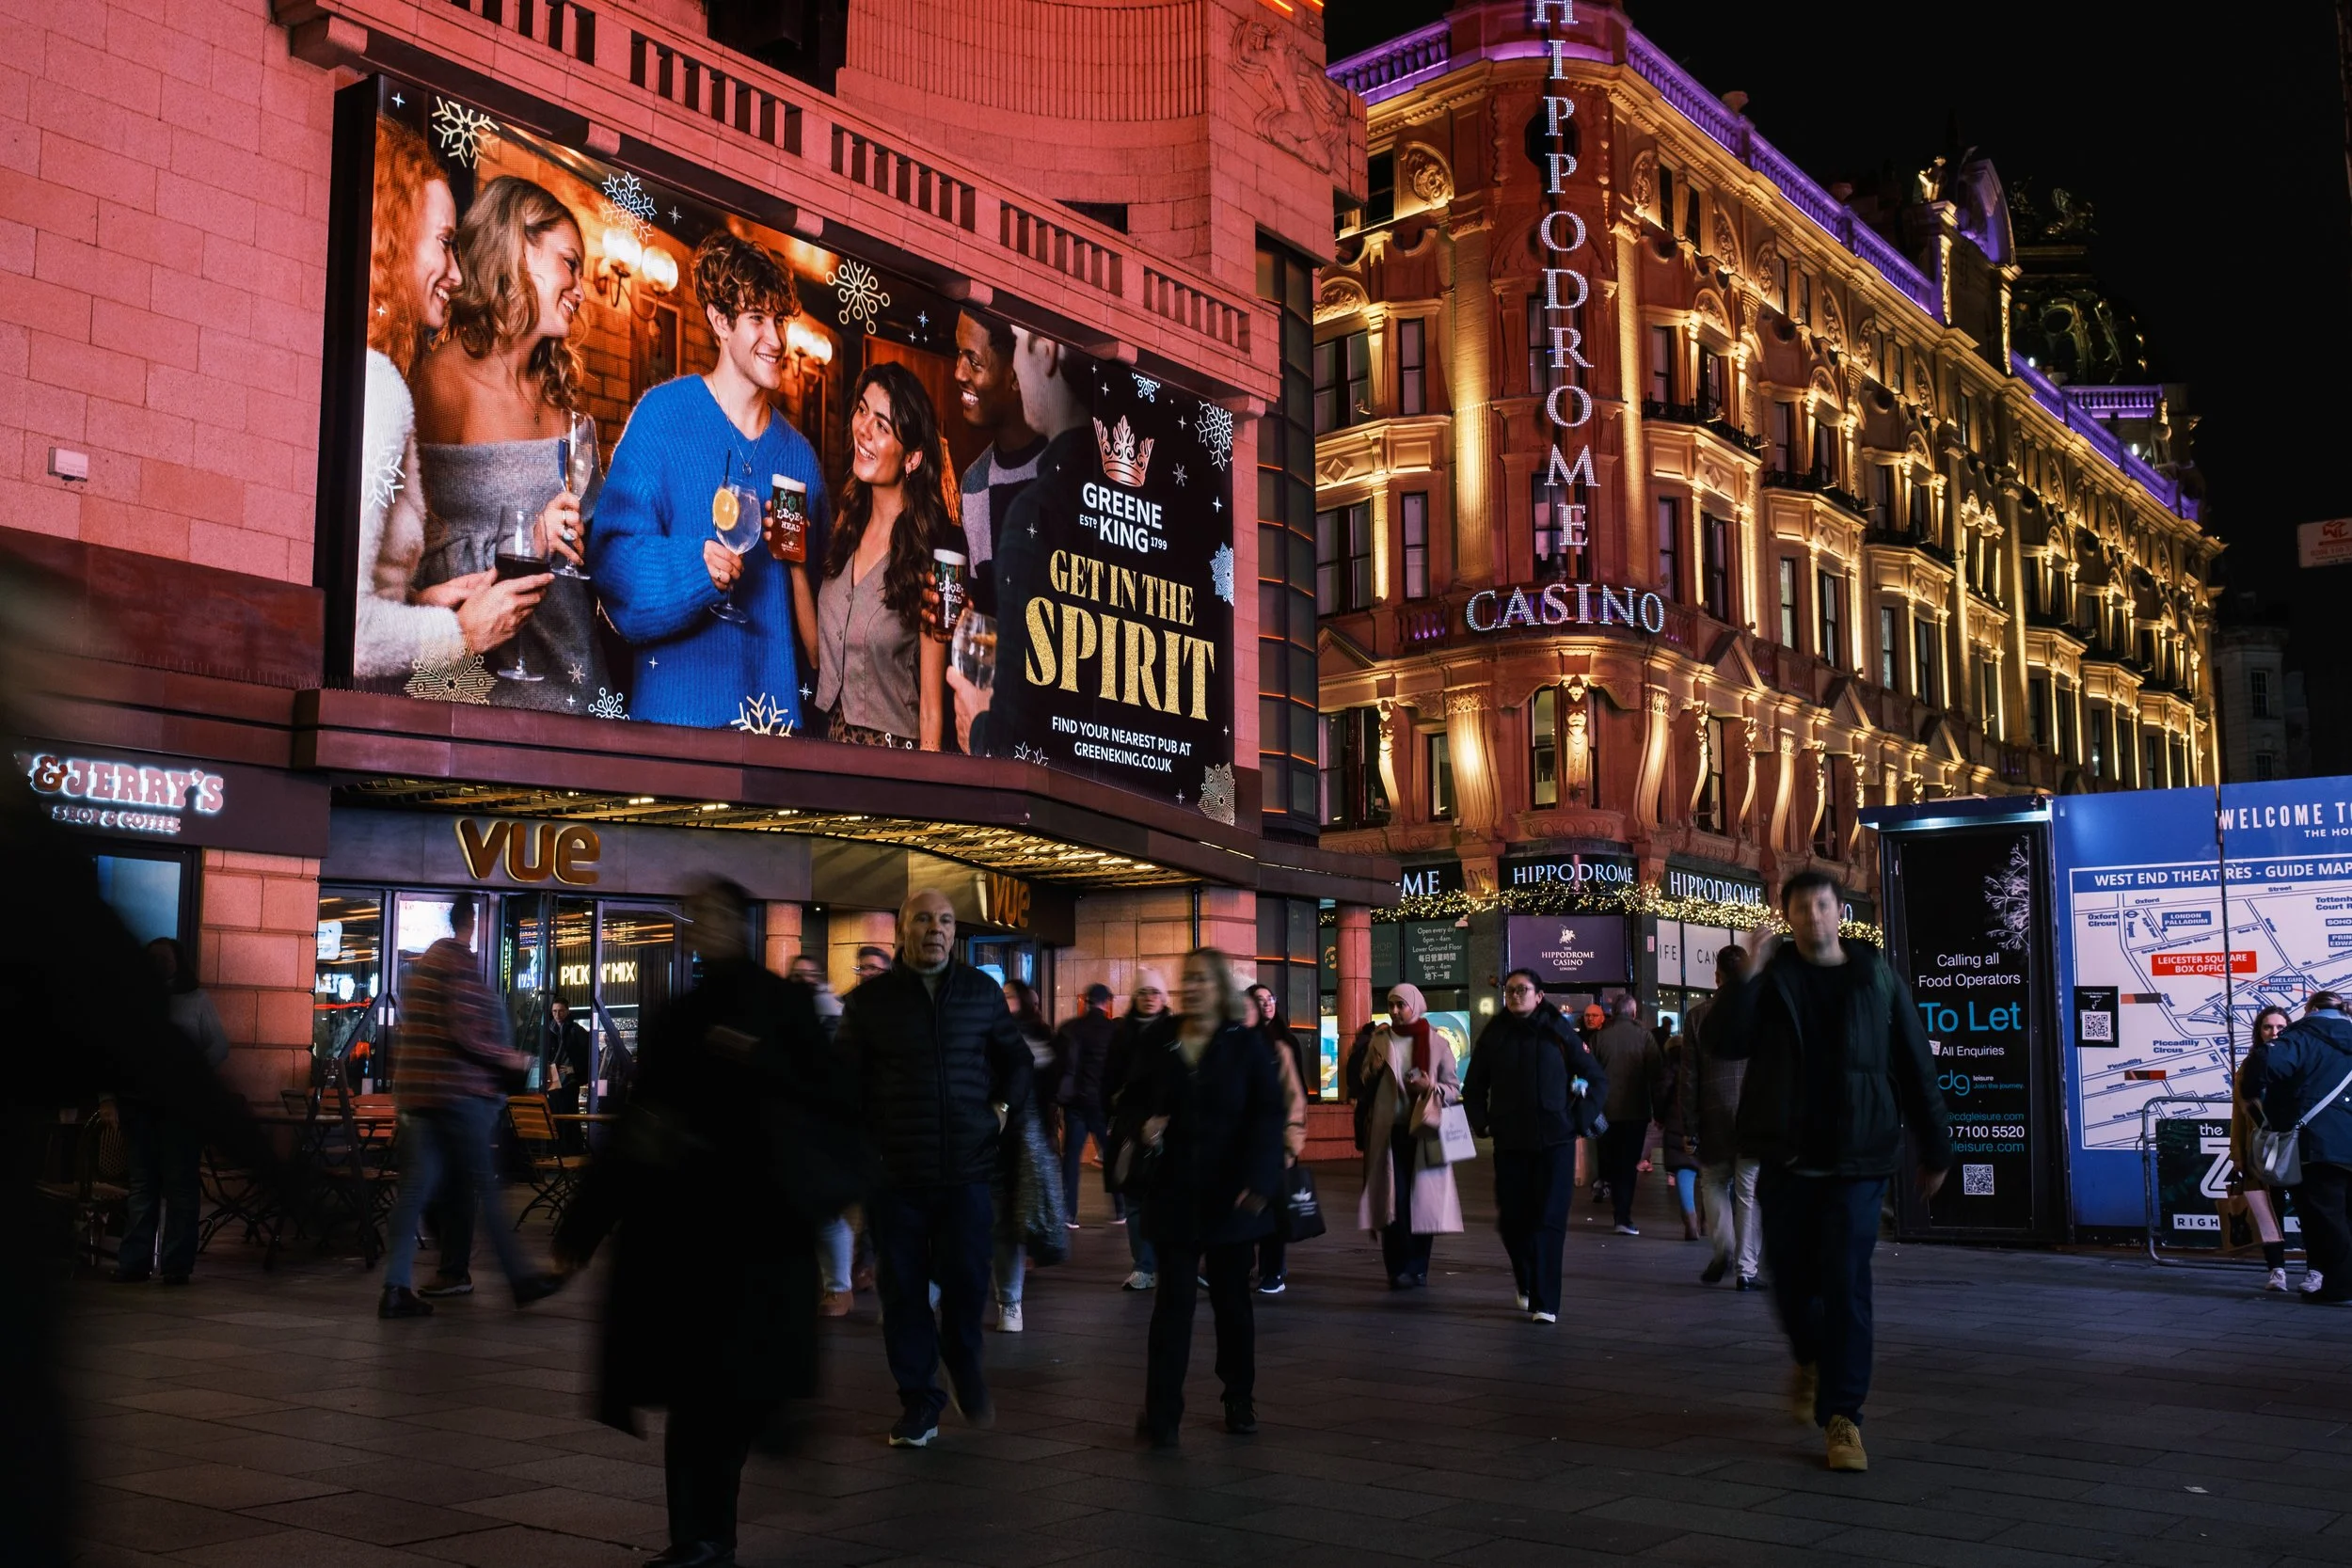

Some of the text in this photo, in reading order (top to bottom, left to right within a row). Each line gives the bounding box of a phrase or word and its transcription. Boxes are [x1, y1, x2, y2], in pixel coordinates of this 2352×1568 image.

[1083, 483, 1163, 530] GREENE
[1100, 515, 1148, 553] KING
[1151, 537, 1167, 550] 1799
[1050, 549, 1194, 626] GET IN THE
[1466, 582, 1665, 633] CASINO
[1025, 596, 1216, 721] SPIRIT
[1052, 716, 1191, 756] FIND YOUR NEAREST PUB AT
[1074, 741, 1172, 772] GREENEKING.CO.UK
[52, 804, 100, 824] SHOP
[117, 813, 182, 833] COFFEE
[2215, 802, 2352, 830] WELCOME T
[2304, 827, 2352, 838] THE HO
[1513, 863, 1633, 885] HIPPODROME
[2094, 873, 2133, 886] WEST
[2137, 872, 2168, 884] END
[2265, 863, 2313, 878] GUIDE
[2318, 862, 2352, 875] MAP
[1670, 871, 1761, 905] HIPPODROME
[1417, 926, 1456, 937] Open every day
[1422, 936, 1435, 945] 6pm
[1428, 943, 1448, 952] Ground
[1422, 963, 1435, 973] 6pm
[1937, 952, 1999, 969] Calling all
[2157, 956, 2203, 965] LEICESTER
[561, 964, 590, 986] PICK
[1918, 974, 2021, 989] Food Operators
[1918, 1001, 2022, 1033] To Let
[1941, 1045, 2005, 1058] All Enquiries
[2107, 1057, 2142, 1069] Piccadilly
[1956, 1125, 1989, 1138] 7100
[1991, 1125, 2025, 1138] 5520
[2200, 1123, 2224, 1136] the
